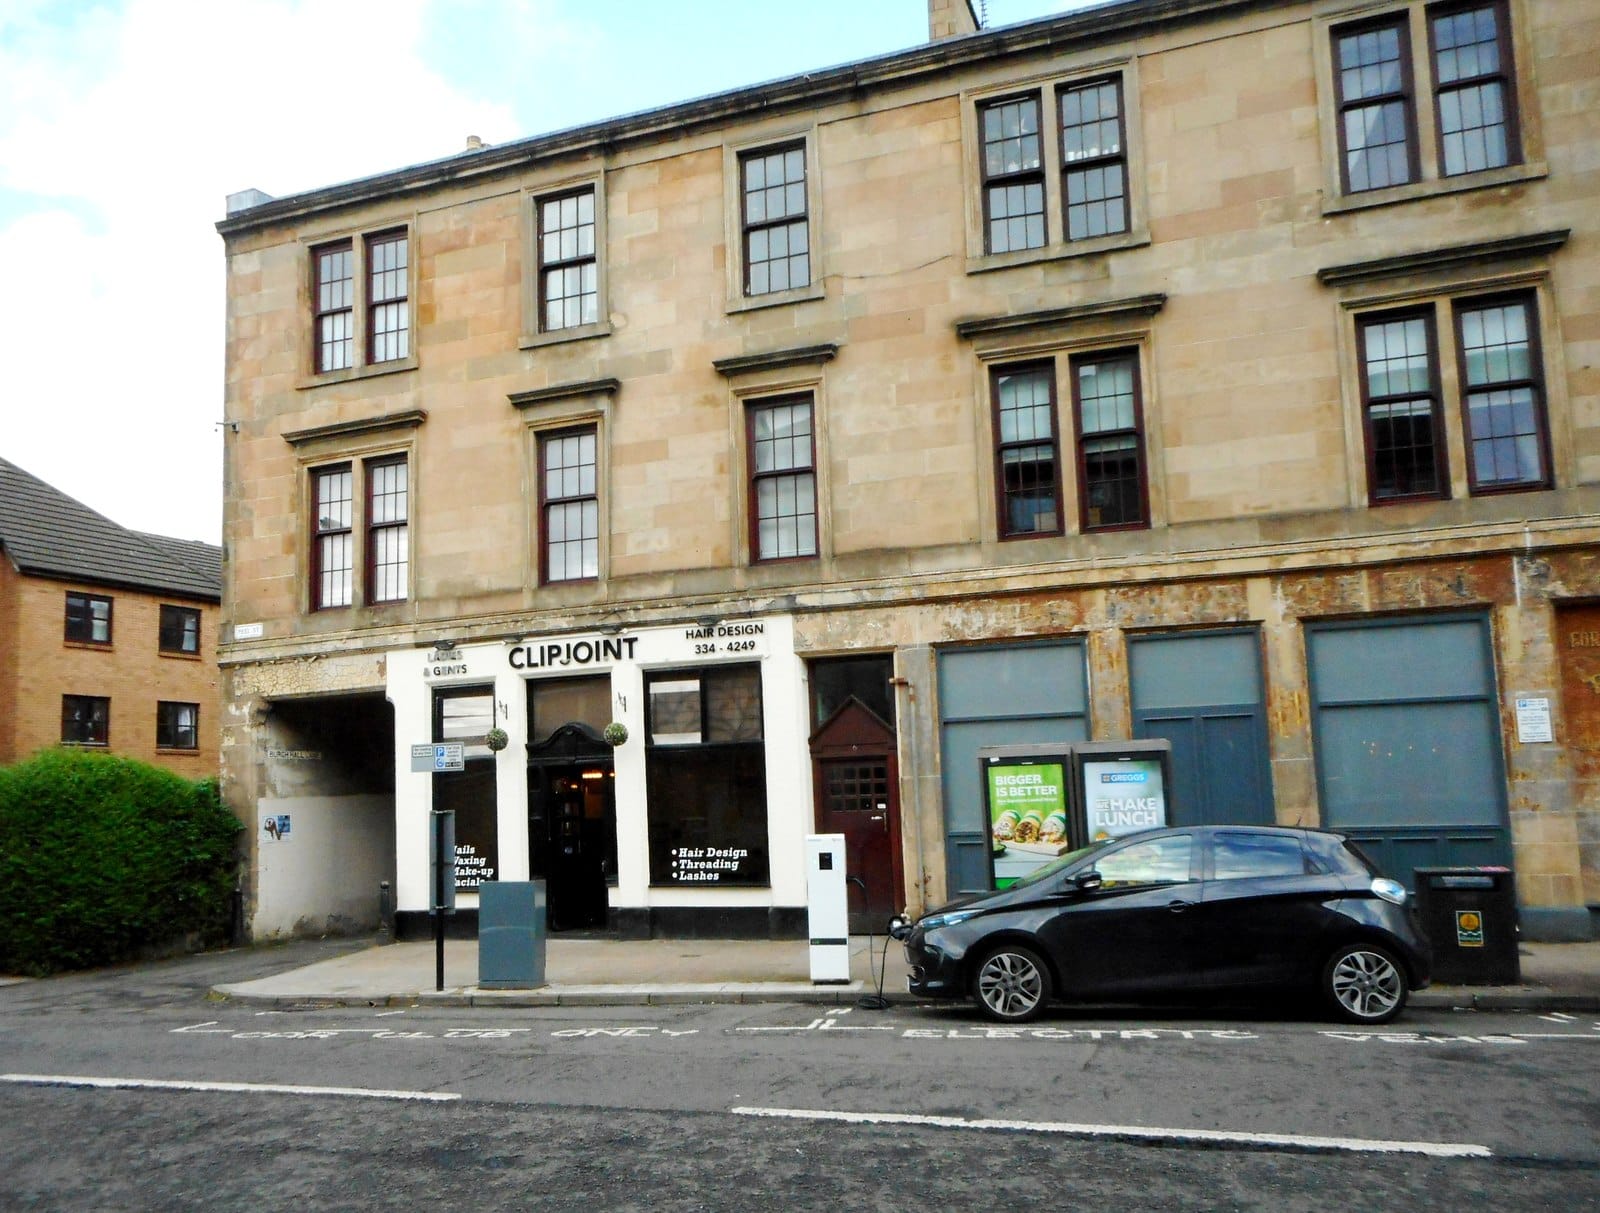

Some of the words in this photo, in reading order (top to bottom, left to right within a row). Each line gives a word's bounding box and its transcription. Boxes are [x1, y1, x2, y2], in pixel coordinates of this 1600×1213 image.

[685, 627, 714, 639] HAIR
[718, 623, 764, 637] DESIGN
[508, 636, 639, 670] CLIPJOINT
[695, 643, 715, 655] 334
[726, 640, 756, 652] 4249
[433, 664, 467, 676] GENTS
[436, 746, 445, 757] P
[995, 774, 1042, 786] BIGGER
[1111, 774, 1145, 782] GREGGS
[996, 787, 1008, 797] IS
[1009, 785, 1058, 797] BETTER
[1110, 798, 1157, 811] MAKE
[1095, 811, 1158, 827] LUNCH
[678, 847, 704, 858] Hair
[706, 847, 748, 860] Design
[679, 859, 740, 872] Threading
[678, 870, 720, 881] Lashes
[454, 877, 486, 887] acial
